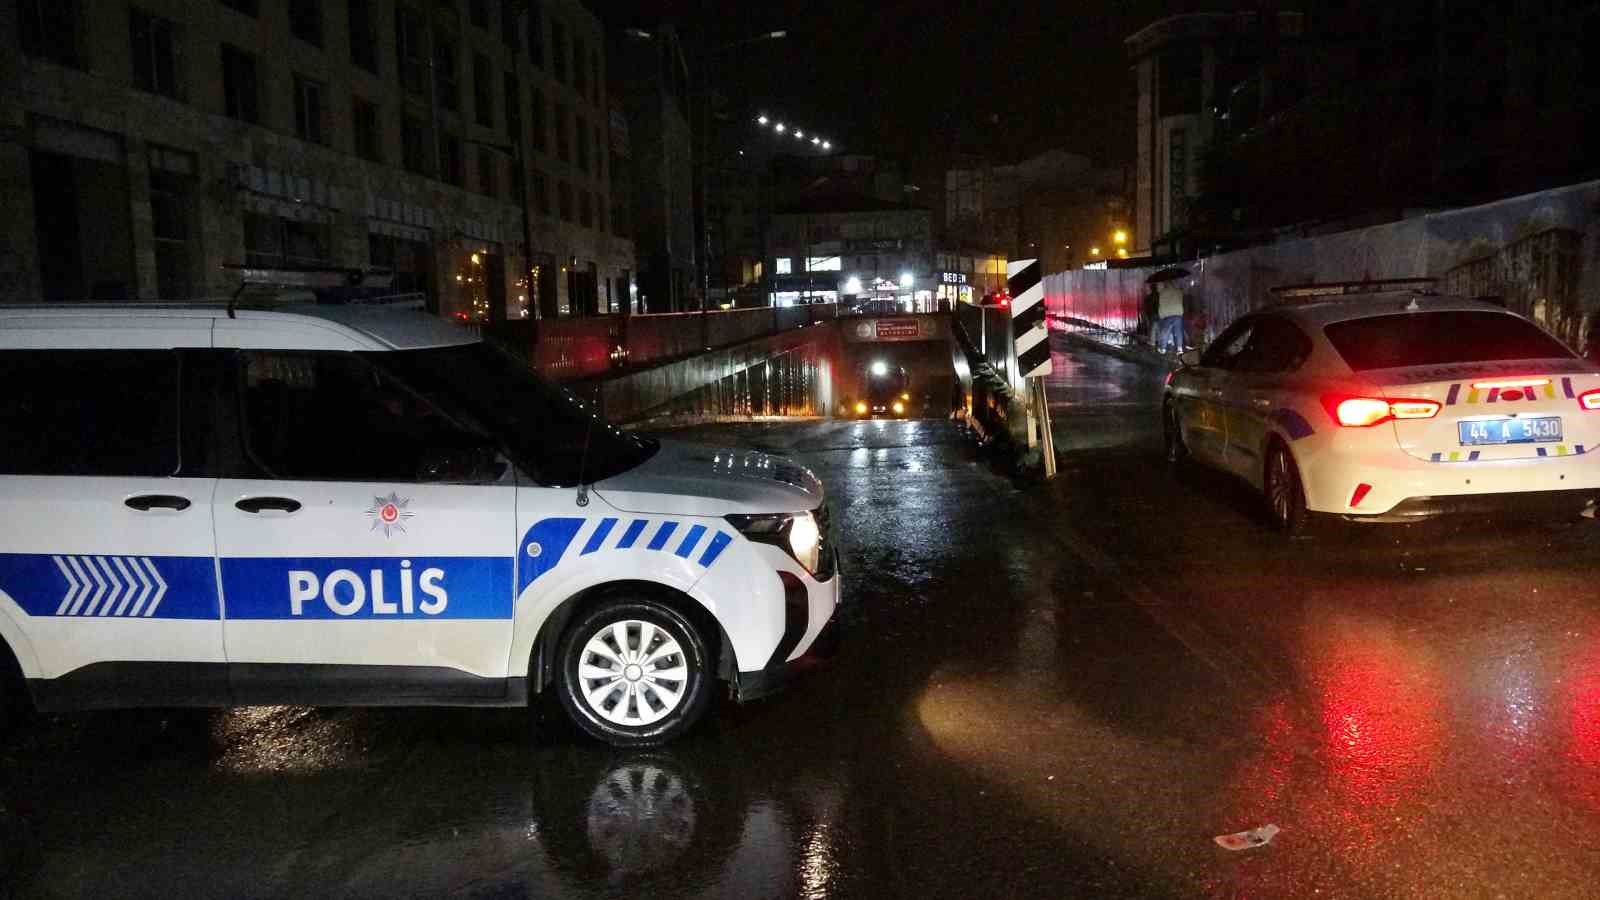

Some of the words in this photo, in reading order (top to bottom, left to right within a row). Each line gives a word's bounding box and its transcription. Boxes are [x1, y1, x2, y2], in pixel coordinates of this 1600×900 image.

[1470, 423, 1488, 439] 44
[1502, 421, 1511, 438] A
[1522, 420, 1558, 437] 5430
[288, 559, 448, 616] POLİS
